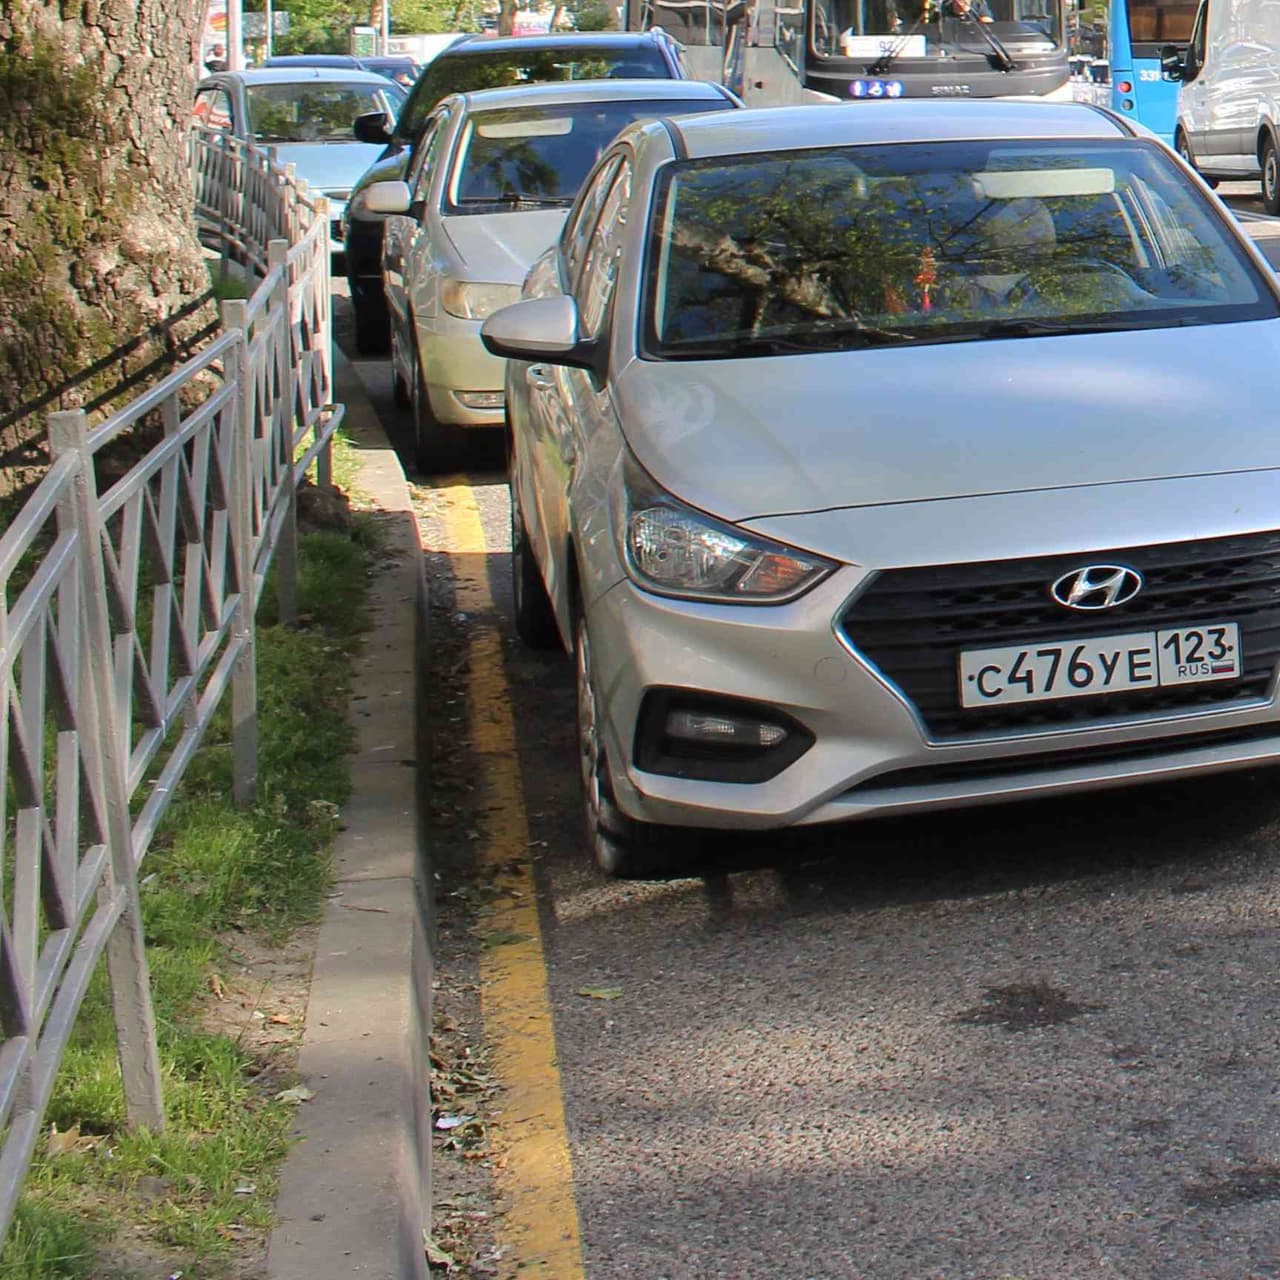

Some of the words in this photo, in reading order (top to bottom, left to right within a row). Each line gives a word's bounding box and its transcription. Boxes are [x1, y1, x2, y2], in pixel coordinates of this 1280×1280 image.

[976, 645, 1153, 698] С476УЕ
[1163, 627, 1228, 665] 123
[1178, 662, 1210, 678] RUS
